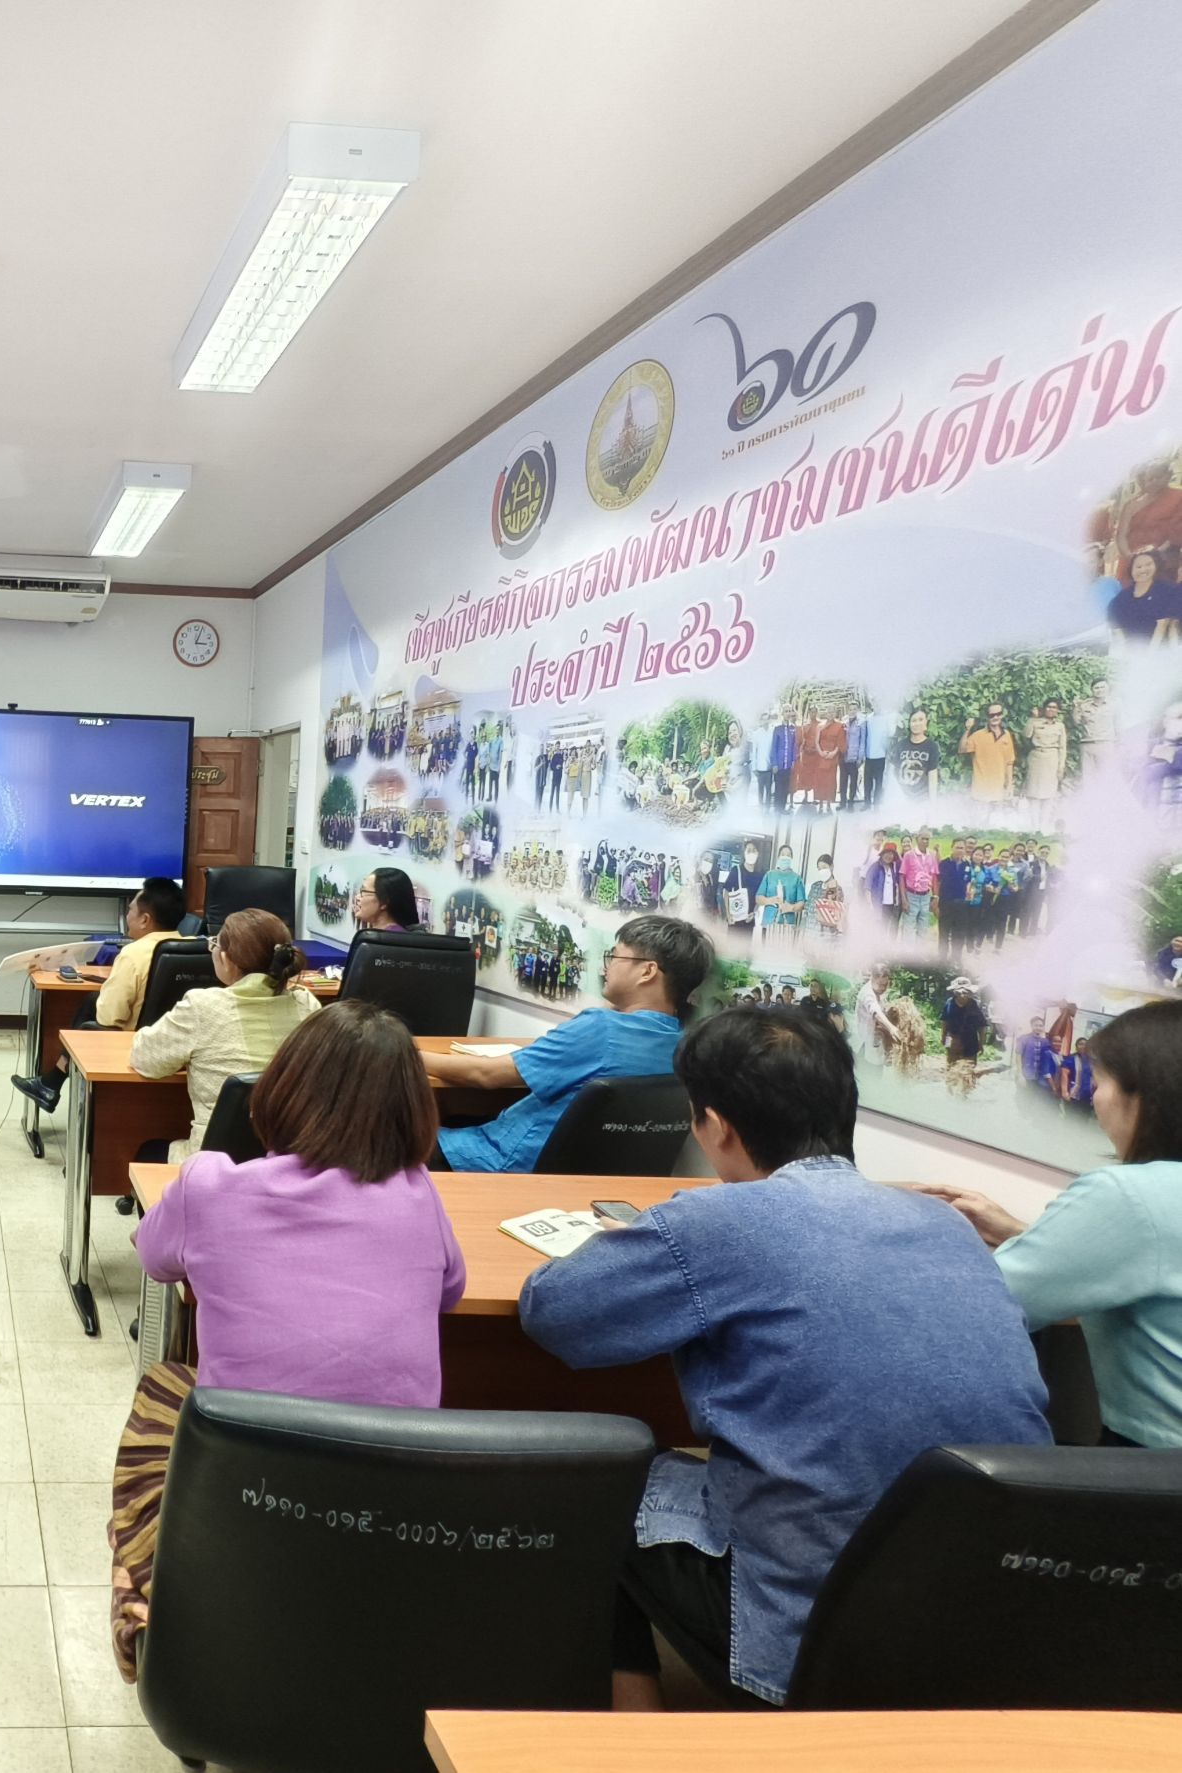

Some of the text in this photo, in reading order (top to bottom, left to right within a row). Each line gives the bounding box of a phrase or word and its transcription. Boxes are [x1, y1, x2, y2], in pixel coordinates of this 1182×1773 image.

[511, 592, 755, 708] ประจำปี ๒๕๖๖
[70, 793, 146, 807] VERTEX
